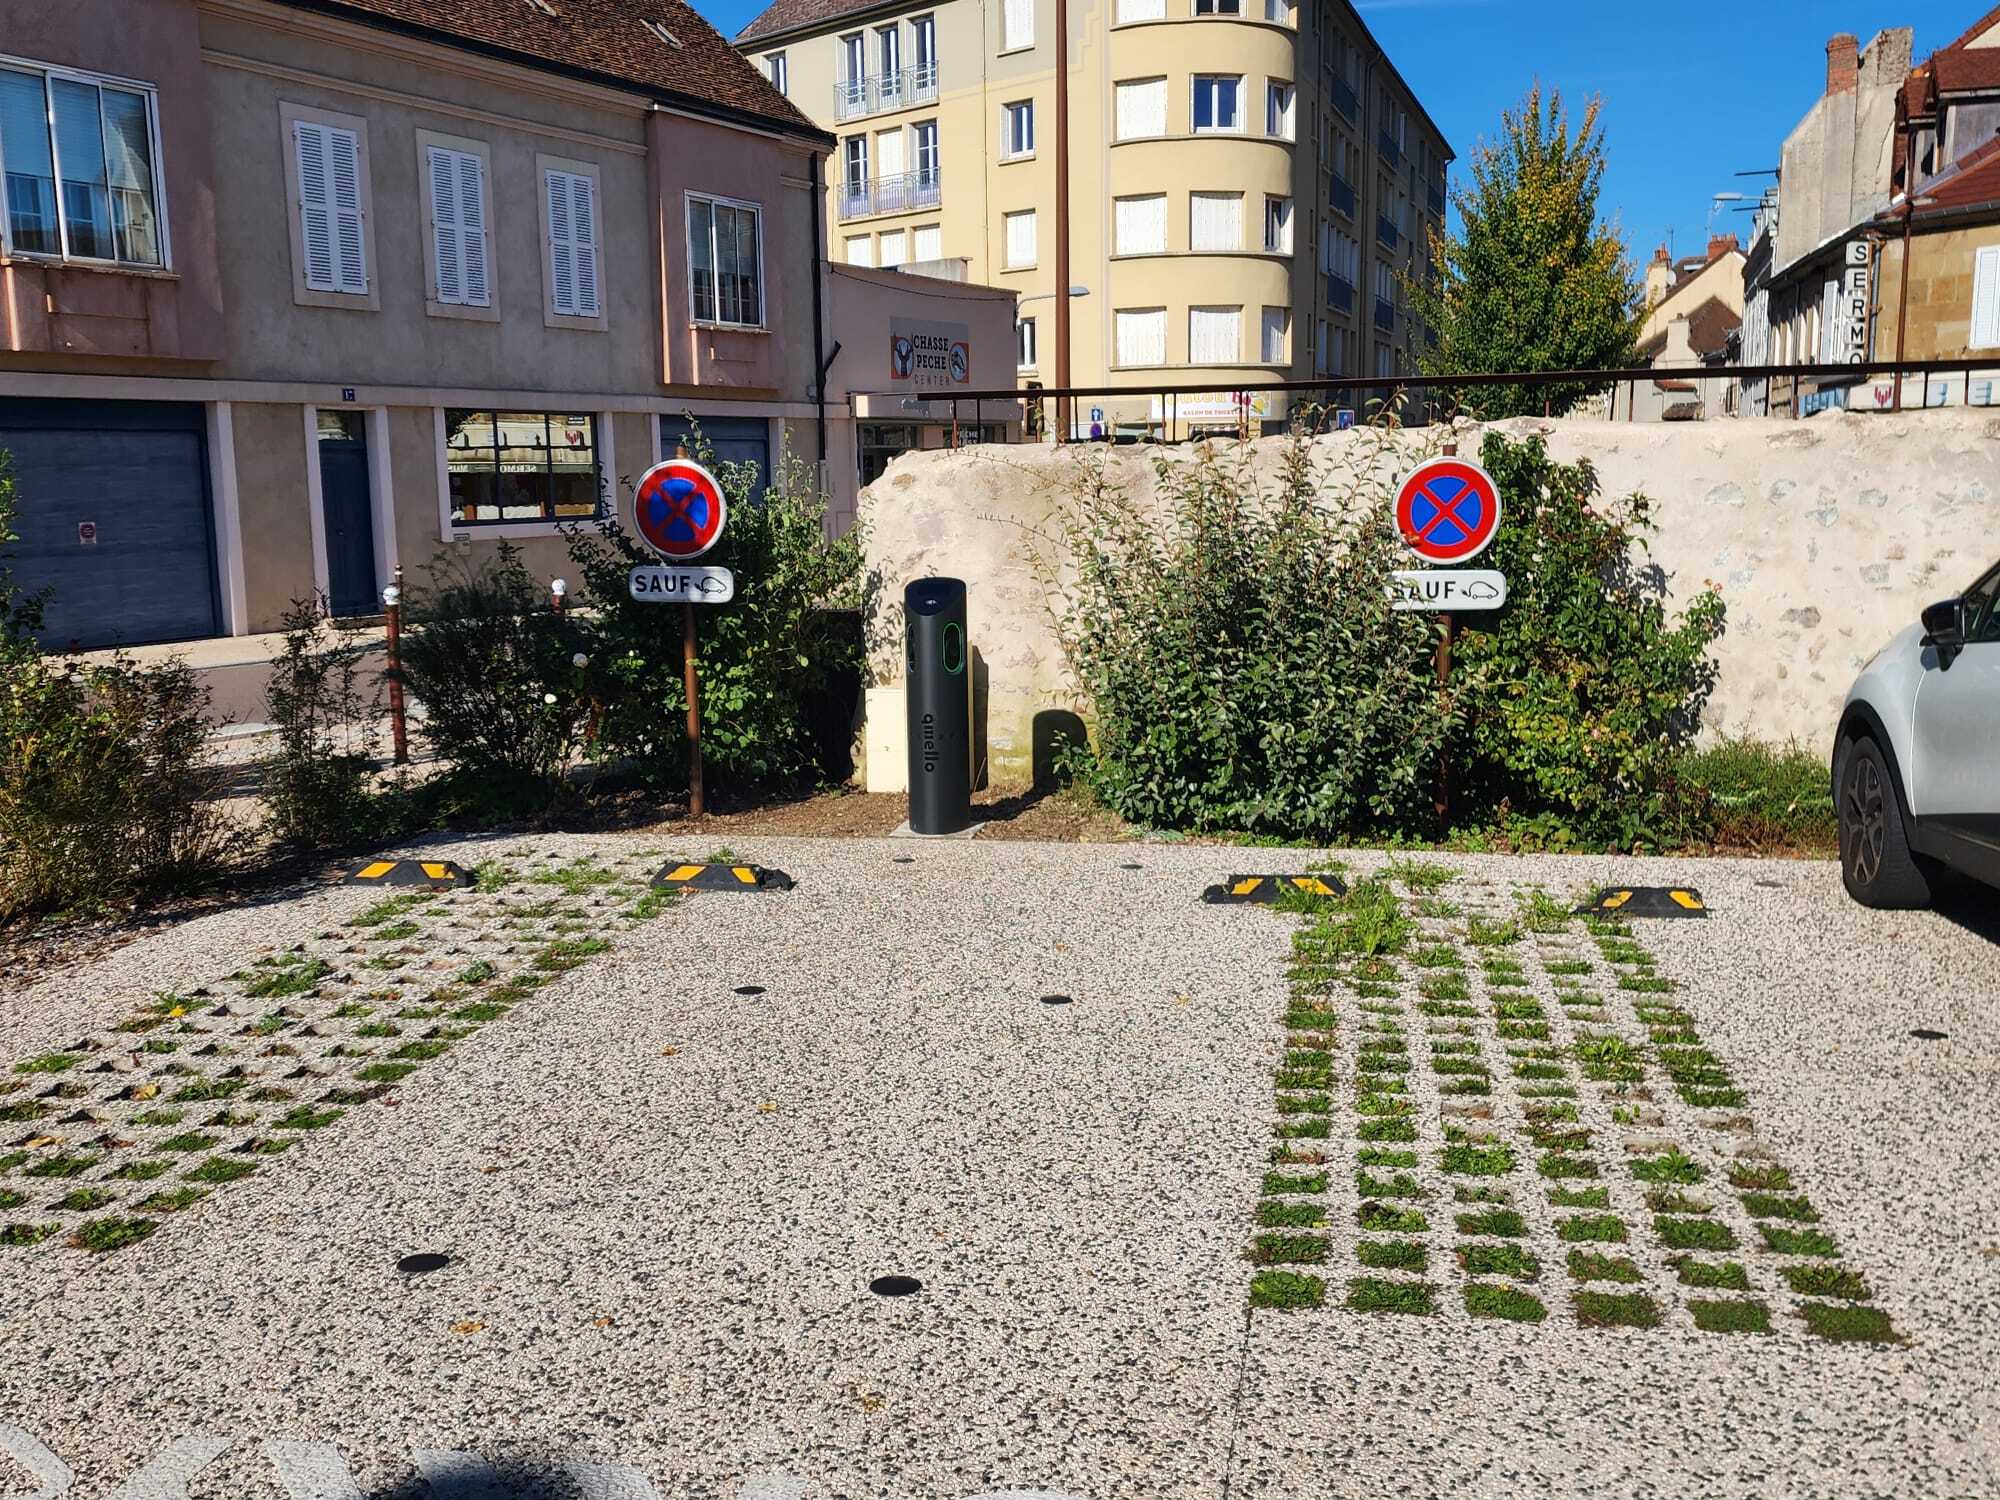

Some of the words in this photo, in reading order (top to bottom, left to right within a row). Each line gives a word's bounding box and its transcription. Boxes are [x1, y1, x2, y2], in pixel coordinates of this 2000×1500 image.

[913, 334, 949, 352] CHASSE
[916, 354, 947, 370] PECHE
[635, 574, 691, 593] SAUF
[1392, 581, 1456, 599] SAUF
